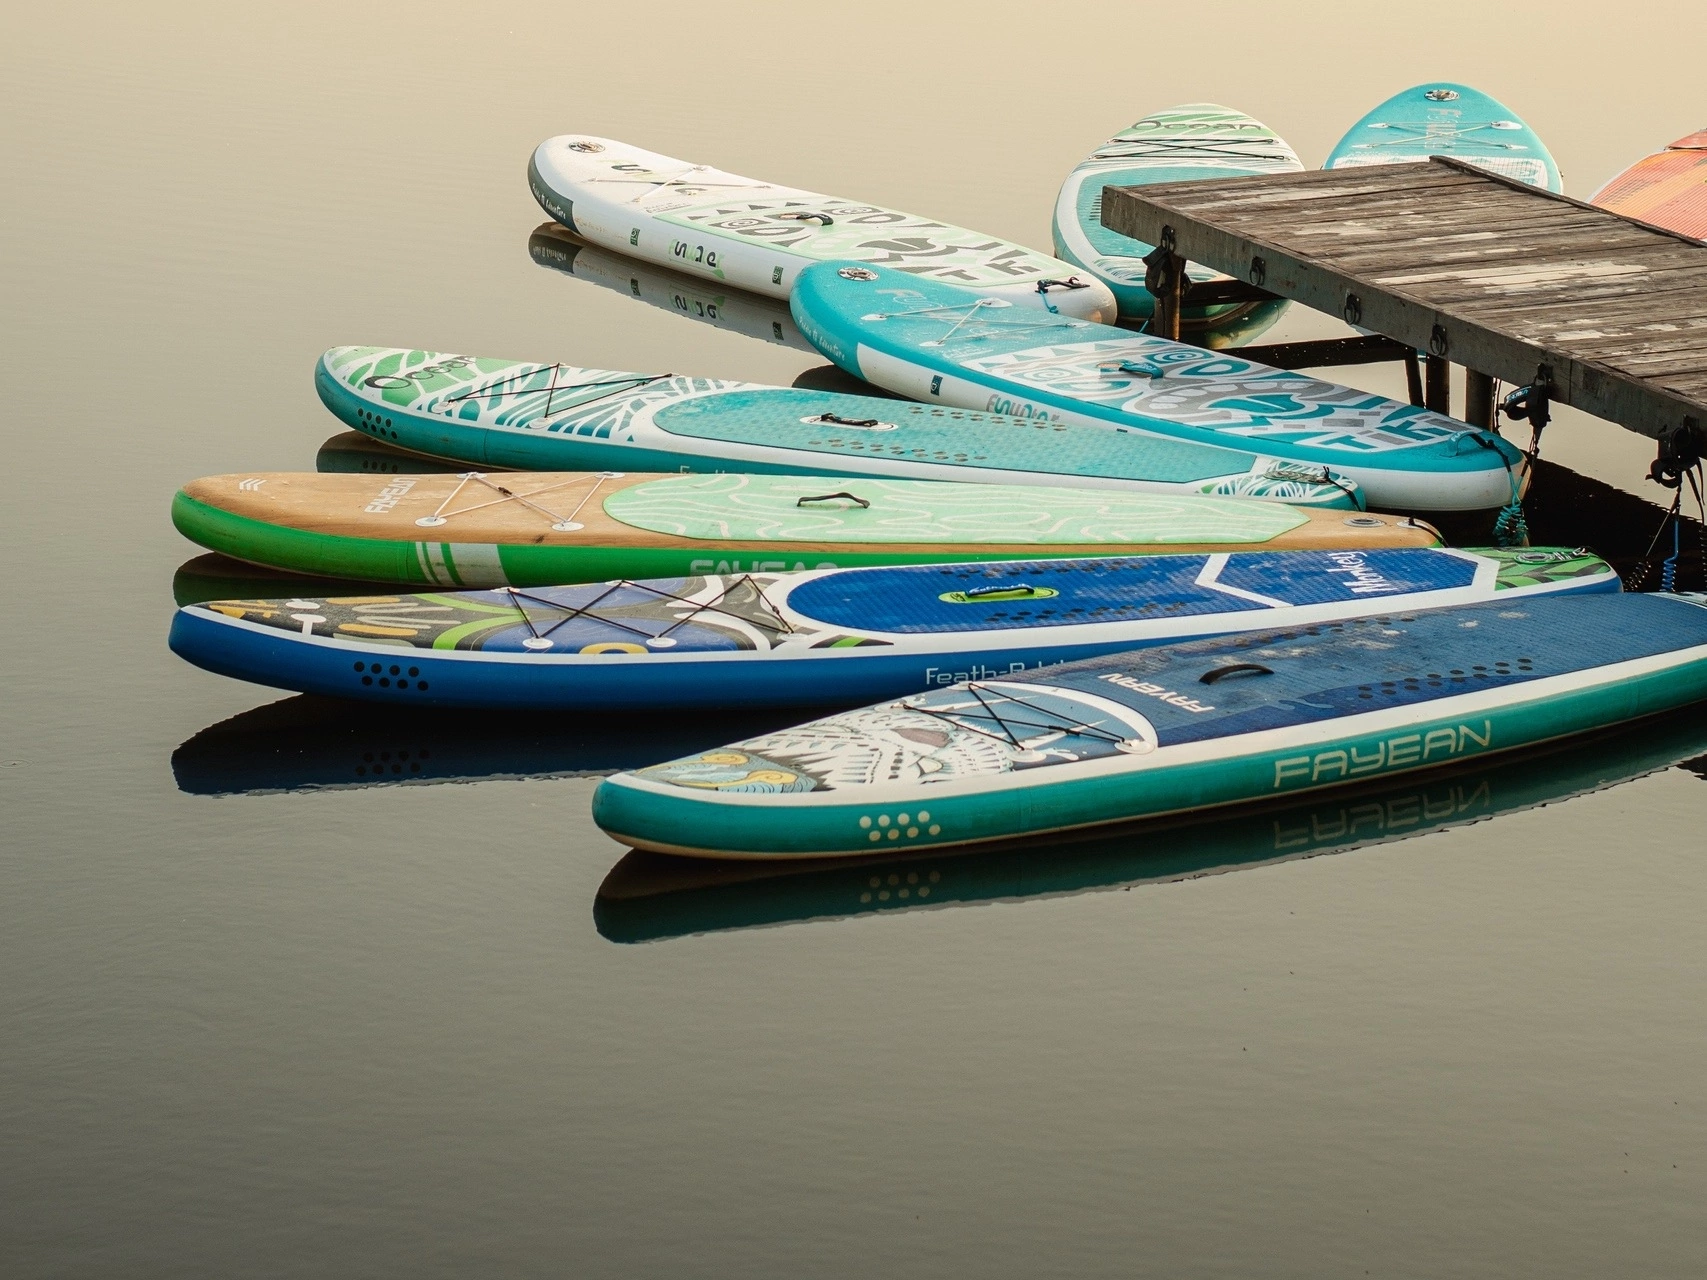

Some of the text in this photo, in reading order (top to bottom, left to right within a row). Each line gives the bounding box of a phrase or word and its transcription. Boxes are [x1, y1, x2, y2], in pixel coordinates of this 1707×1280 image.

[1131, 120, 1262, 131] Ocean
[364, 355, 476, 390] Ocean
[690, 559, 839, 579] FAYE
[1325, 551, 1398, 594] Monkey
[1098, 672, 1216, 713] FAYEAN
[1273, 720, 1491, 789] FAYEAN
